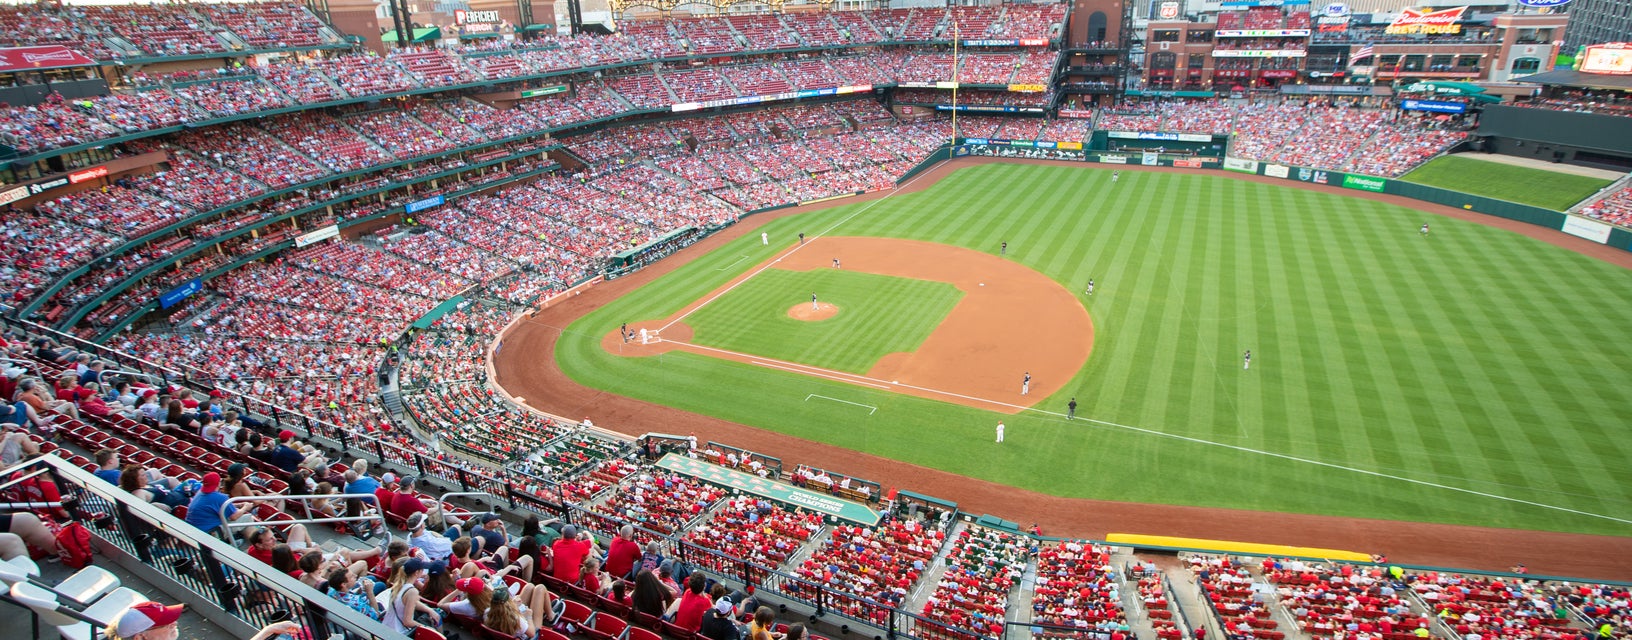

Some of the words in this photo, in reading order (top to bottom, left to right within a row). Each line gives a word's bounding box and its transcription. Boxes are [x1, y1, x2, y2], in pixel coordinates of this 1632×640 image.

[456, 10, 499, 24] PERFICIENT
[1391, 13, 1463, 24] Budweiser
[466, 23, 492, 31] PERCH
[1386, 24, 1418, 34] BREW
[1420, 24, 1461, 34] HOUSE
[1354, 178, 1384, 187] National
[788, 494, 841, 512] CHAMPIONS
[793, 491, 819, 501] WORLD
[818, 498, 844, 507] SERIES
